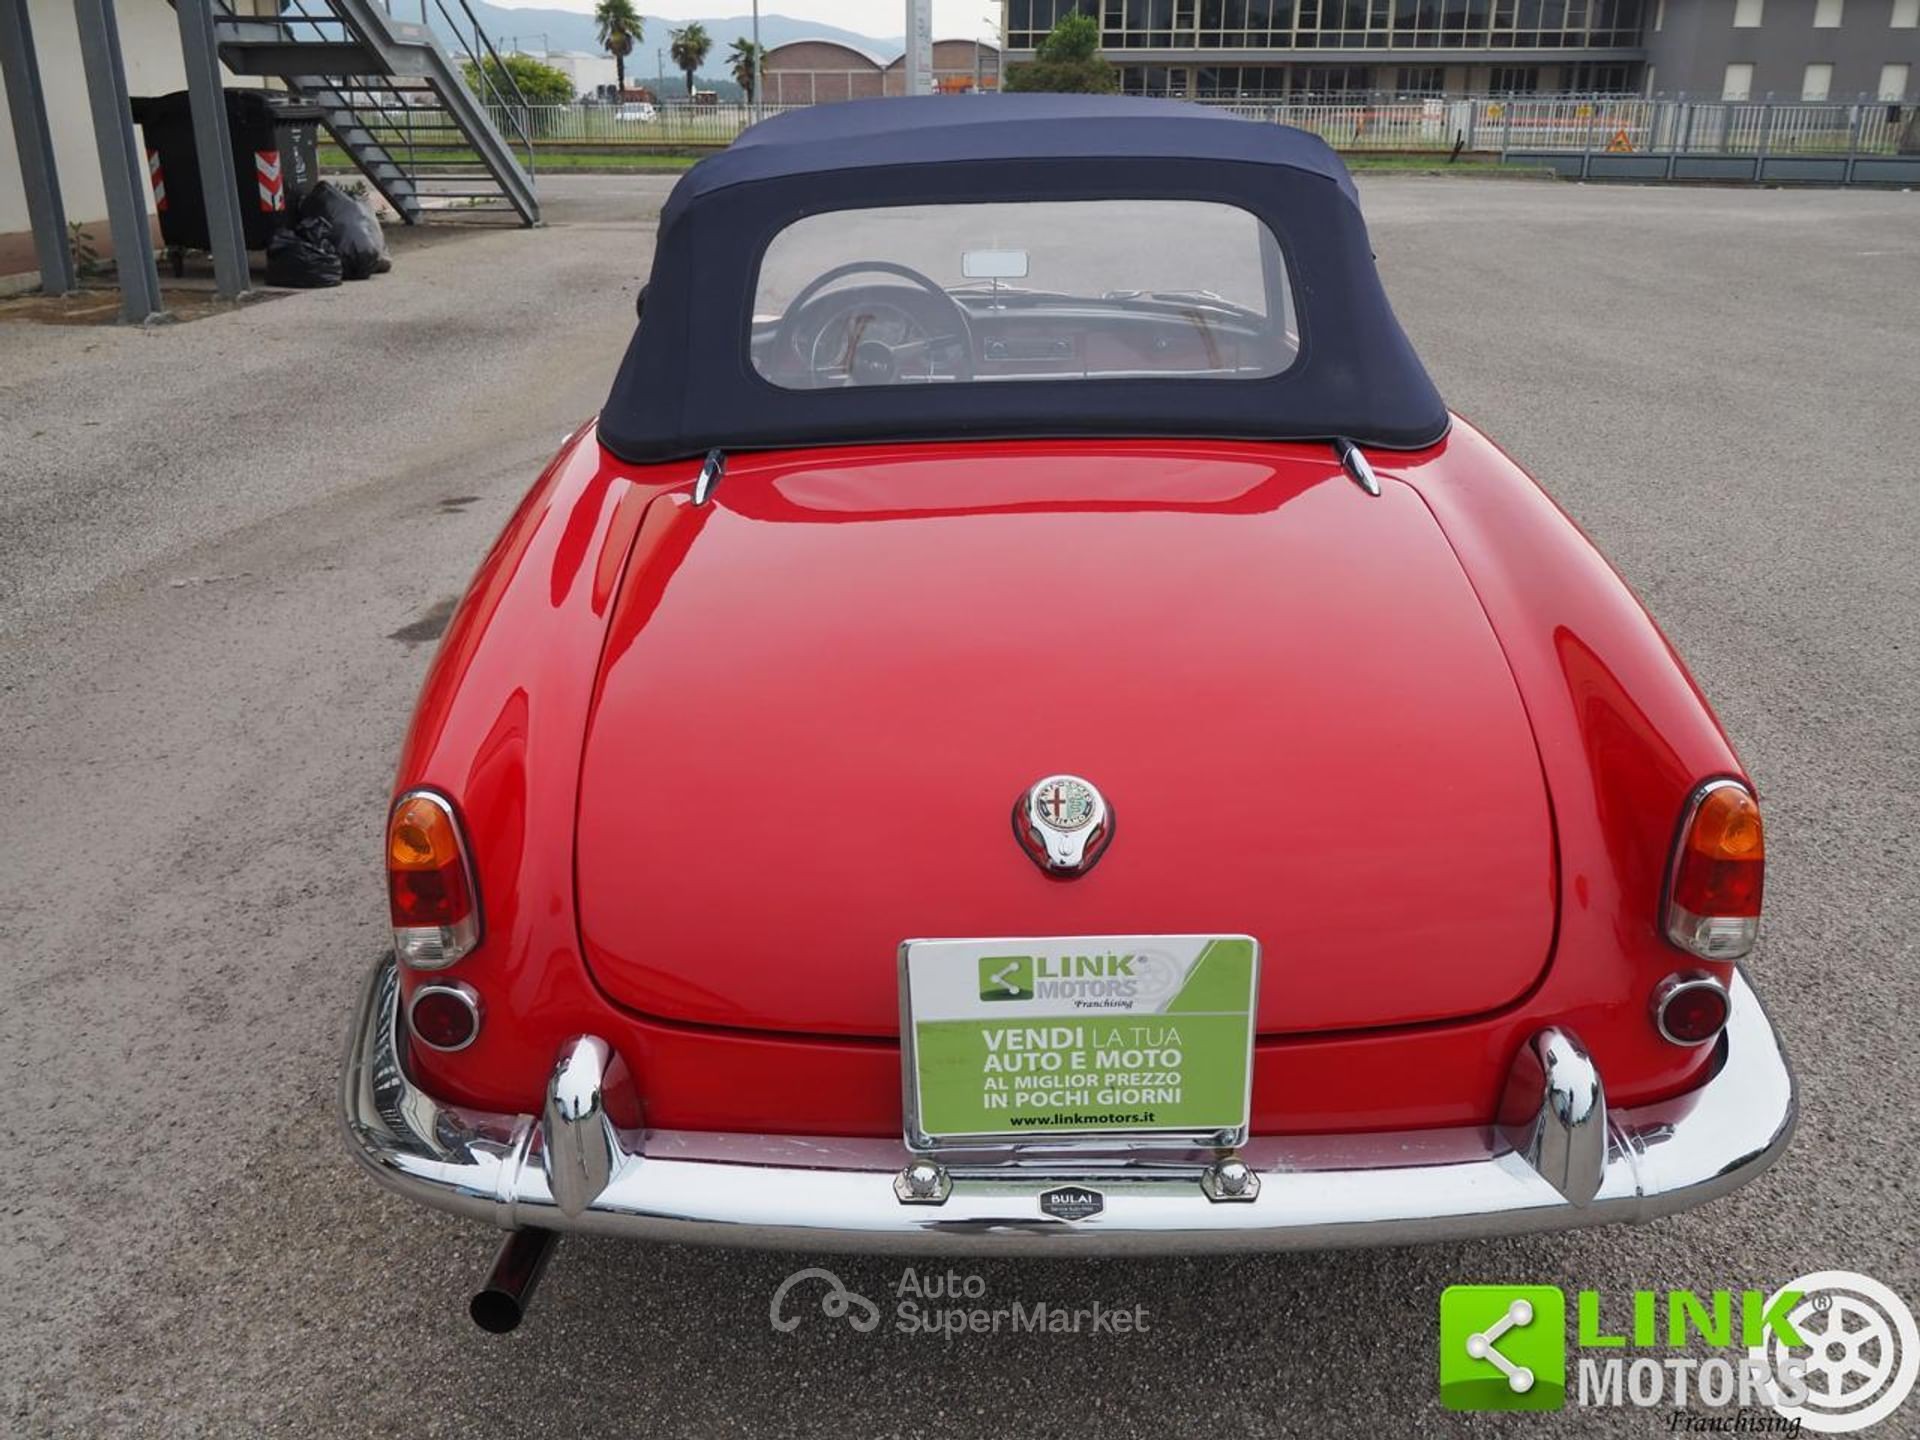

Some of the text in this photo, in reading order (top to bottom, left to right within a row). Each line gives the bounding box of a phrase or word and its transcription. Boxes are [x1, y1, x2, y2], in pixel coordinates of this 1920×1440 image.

[1038, 980, 1137, 999] MOTORS
[982, 1027, 1182, 1051] VENDI LA TUA
[984, 1049, 1182, 1073] AUTO E MOTO
[984, 1071, 1181, 1090] AL MIGLIOR PREZZO
[984, 1088, 1181, 1109] IN POCHI GIORNI
[1010, 1112, 1155, 1126] www.linkmotors.it
